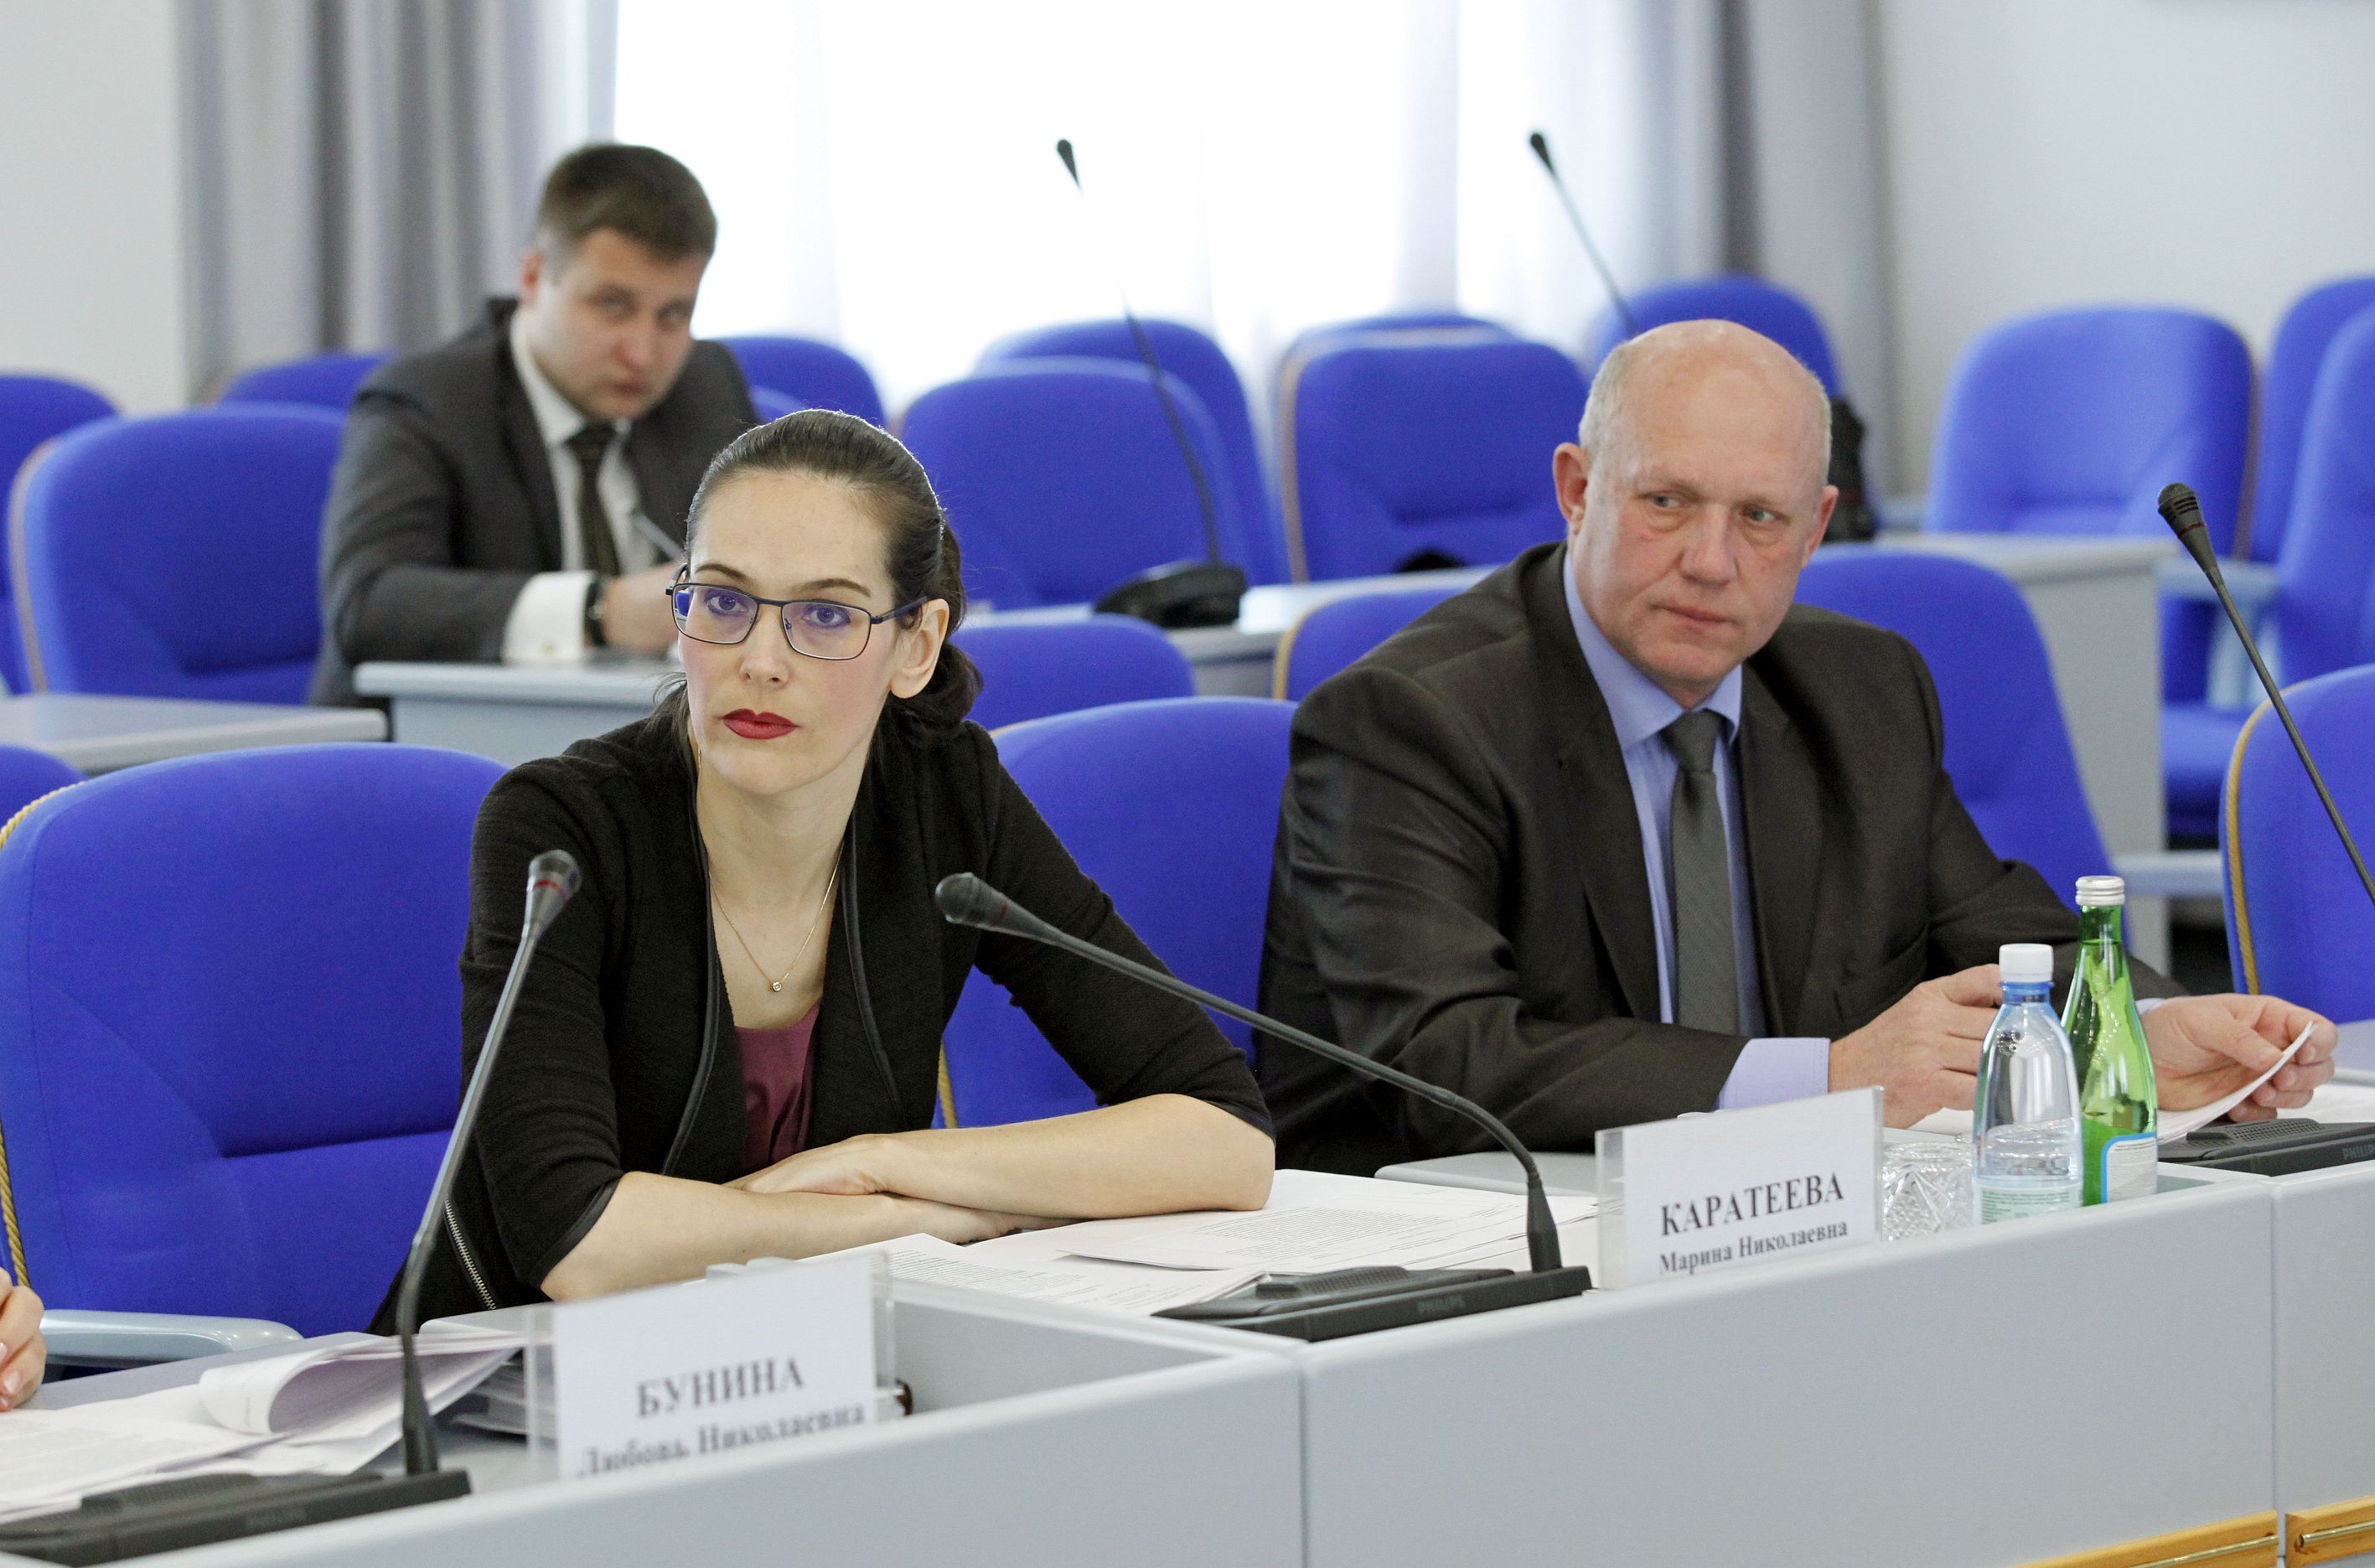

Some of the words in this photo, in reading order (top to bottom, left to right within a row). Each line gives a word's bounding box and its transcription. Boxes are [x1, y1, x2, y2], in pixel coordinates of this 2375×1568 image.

[2342, 1144, 2375, 1160] PHILIP
[1660, 1172, 1845, 1236] КАРАТЕЕВА
[1660, 1246, 1732, 1275] Марина
[1738, 1221, 1848, 1257] Николаевна
[638, 1356, 805, 1418] БУНИНА
[575, 1438, 689, 1478] Любовь
[699, 1404, 864, 1454] Николаевна
